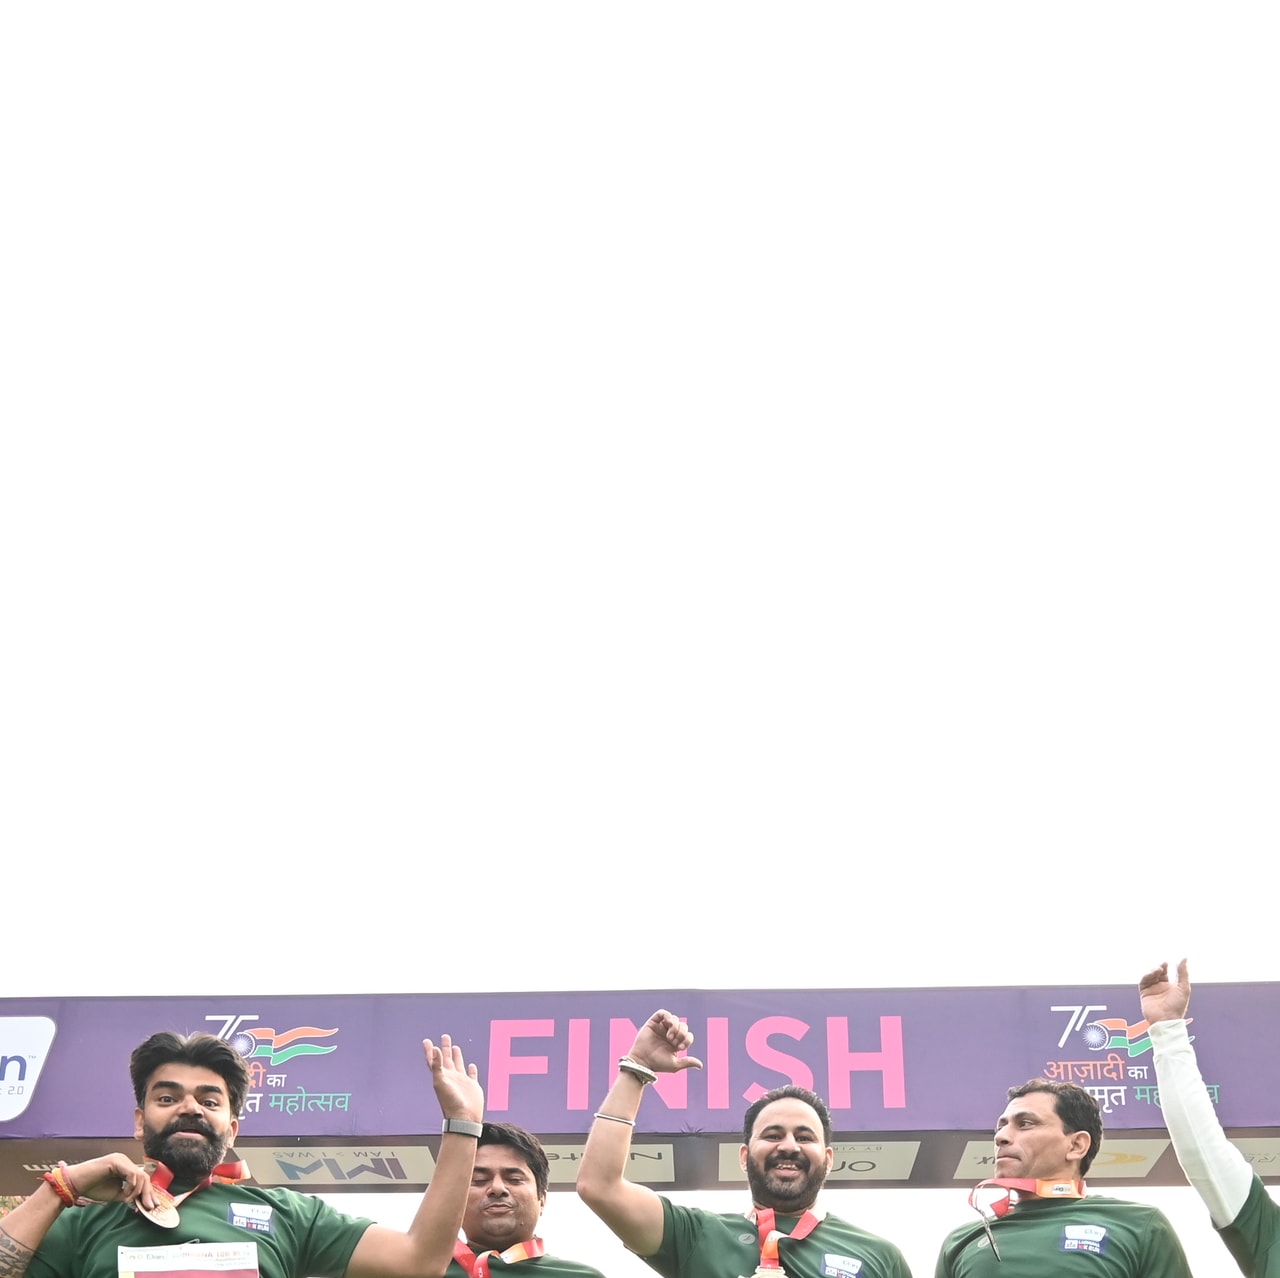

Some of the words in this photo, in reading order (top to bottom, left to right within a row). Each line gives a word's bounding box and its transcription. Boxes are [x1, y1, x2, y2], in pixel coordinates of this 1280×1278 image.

[1127, 1066, 1148, 1080] का
[7, 1085, 24, 1096] 2.0
[269, 1086, 352, 1116] महोत्सव
